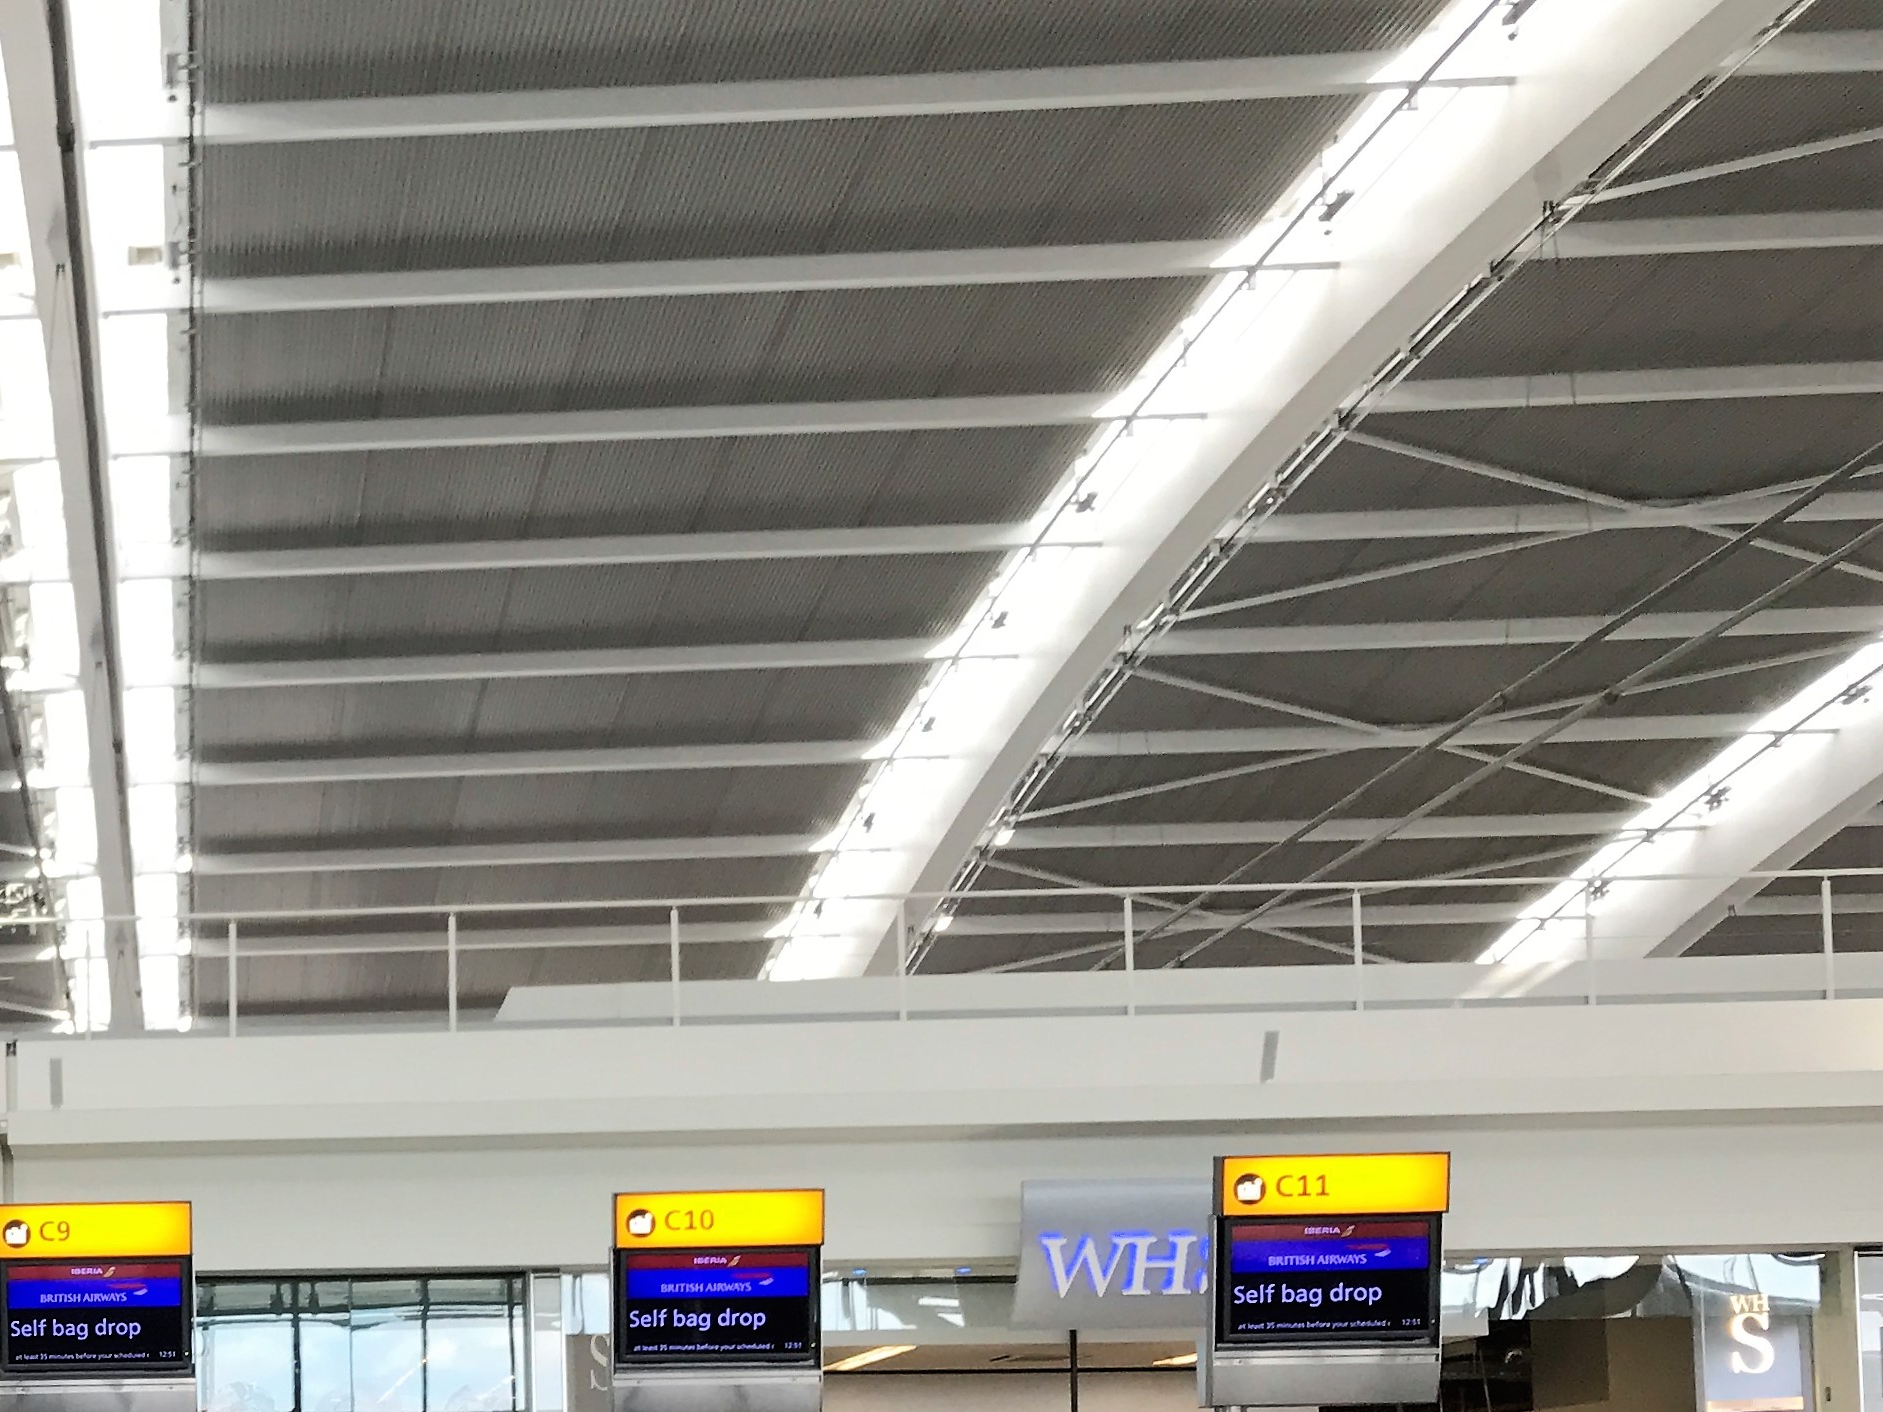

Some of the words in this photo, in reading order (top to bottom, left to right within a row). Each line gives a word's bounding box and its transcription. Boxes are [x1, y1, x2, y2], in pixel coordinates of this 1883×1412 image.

[1276, 1174, 1330, 1197] C11
[39, 1221, 71, 1241] C9
[664, 1209, 715, 1231] C10
[1038, 1229, 1208, 1299] WH
[1268, 1255, 1315, 1267] BRITISH
[1317, 1254, 1368, 1265] AIRWAYS
[40, 1294, 81, 1303] BRITISH
[83, 1293, 127, 1302] AIRWAYS
[660, 1283, 703, 1293] BRITISH
[705, 1282, 752, 1292] AIRWAYS
[1234, 1284, 1274, 1304] Self
[1281, 1284, 1322, 1308] bag
[1330, 1282, 1382, 1306] drop
[1730, 1294, 1770, 1313] WH
[10, 1319, 46, 1337] Self
[52, 1319, 88, 1340] bag
[94, 1318, 141, 1339] drop
[629, 1309, 667, 1328] Self
[673, 1309, 711, 1331] bag
[718, 1308, 766, 1330] drop
[1732, 1312, 1774, 1374] S
